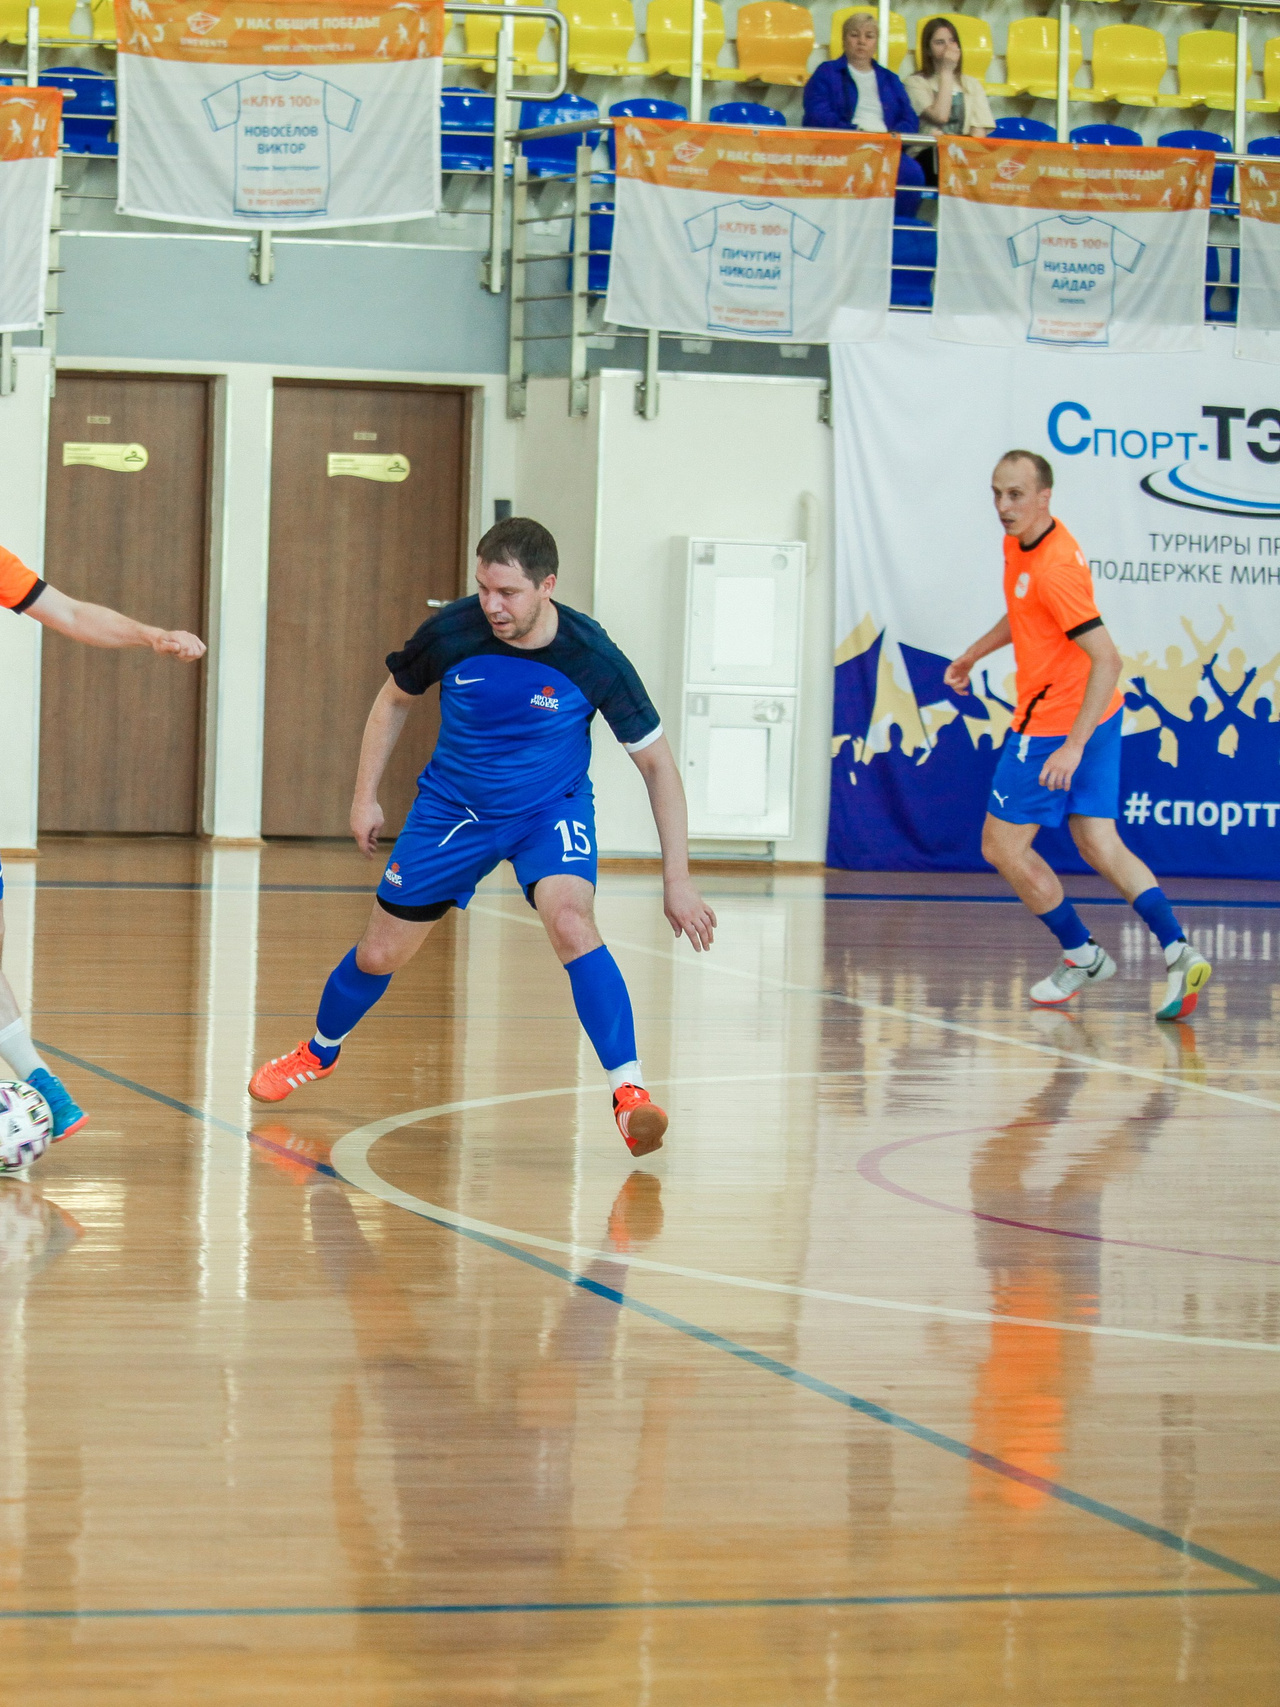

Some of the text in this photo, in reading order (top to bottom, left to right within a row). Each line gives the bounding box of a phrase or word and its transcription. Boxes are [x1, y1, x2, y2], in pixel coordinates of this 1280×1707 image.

[242, 95, 321, 108] «КЛУБ 100»
[244, 123, 318, 138] НОВОСЁЛОВ
[257, 142, 306, 155] ВИКТОР
[722, 247, 781, 263] ПИЧУГИН
[720, 265, 781, 280] НИКОЛАЙ
[1043, 261, 1105, 275] НИЗАМОВ
[1051, 276, 1096, 291] АЙДАР
[1149, 533, 1250, 556] ТУРНИРЫ
[1089, 560, 1280, 585] ПОДДЕРЖКЕ МИН
[554, 819, 591, 856] 15
